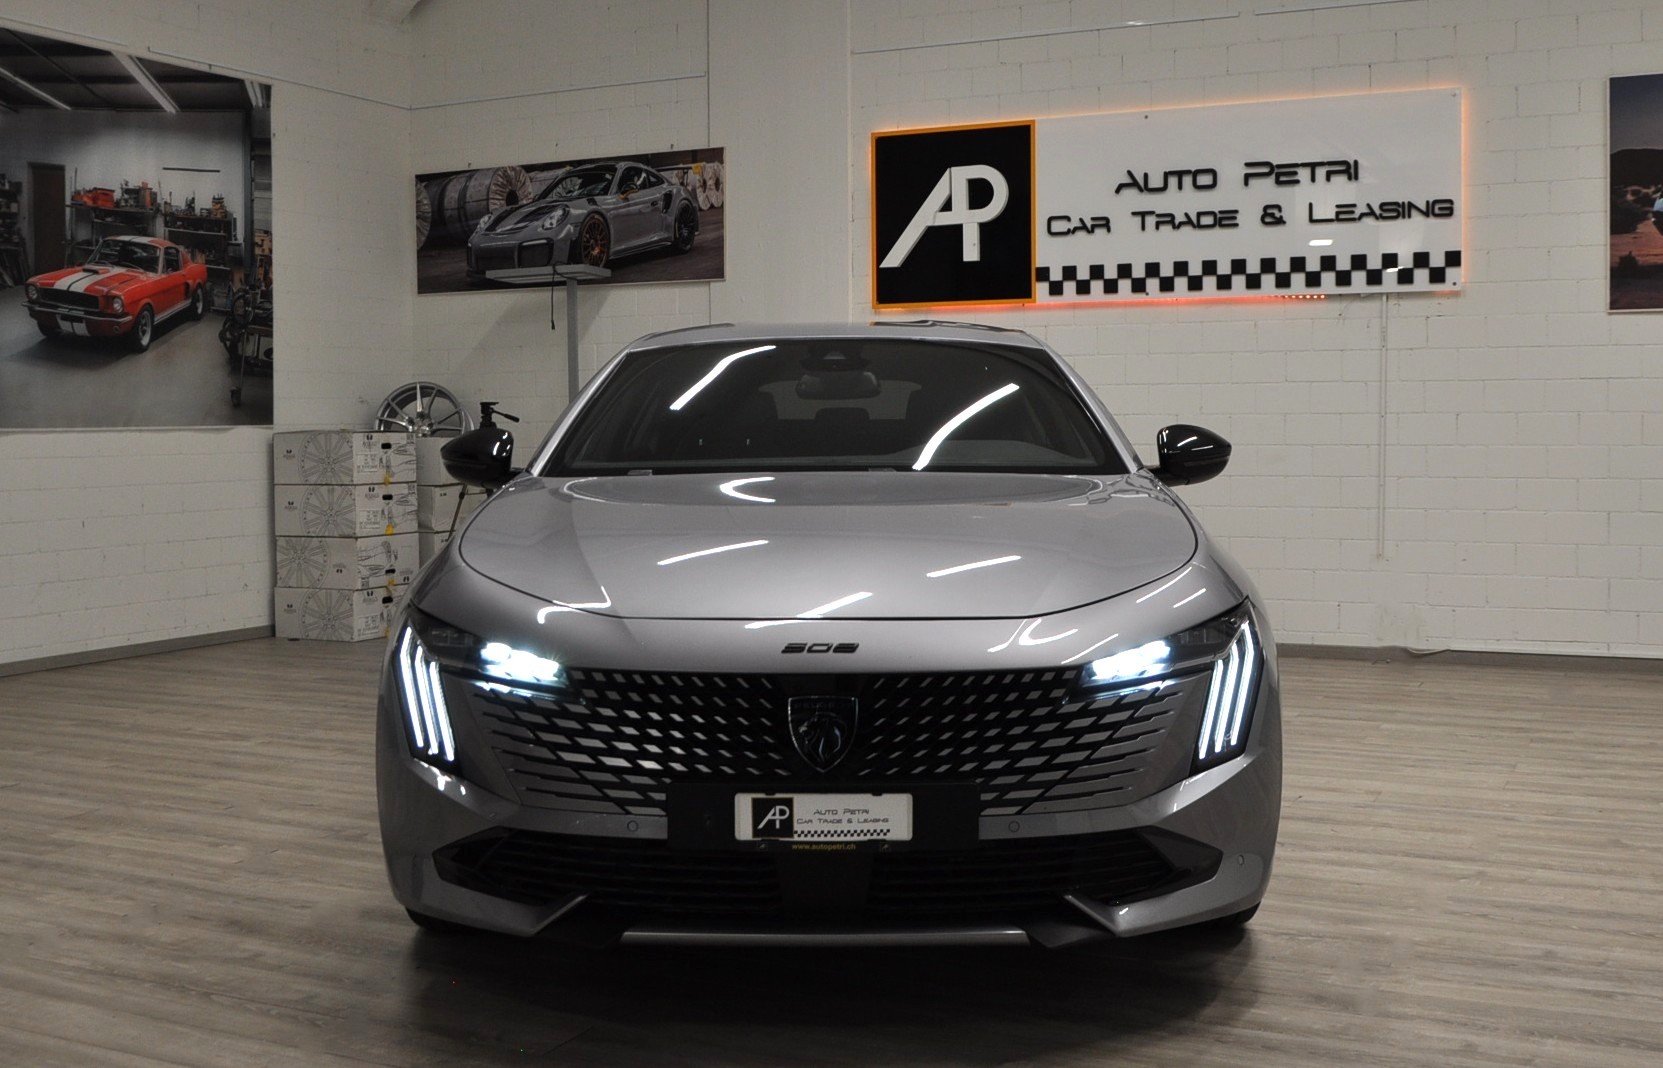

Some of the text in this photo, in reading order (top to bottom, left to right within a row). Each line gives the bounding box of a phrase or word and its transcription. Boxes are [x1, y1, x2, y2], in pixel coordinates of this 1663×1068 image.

[879, 164, 1009, 268] AP
[1260, 203, 1286, 225] &
[781, 643, 859, 654] 508
[791, 843, 856, 851] www.autopetri.ch
